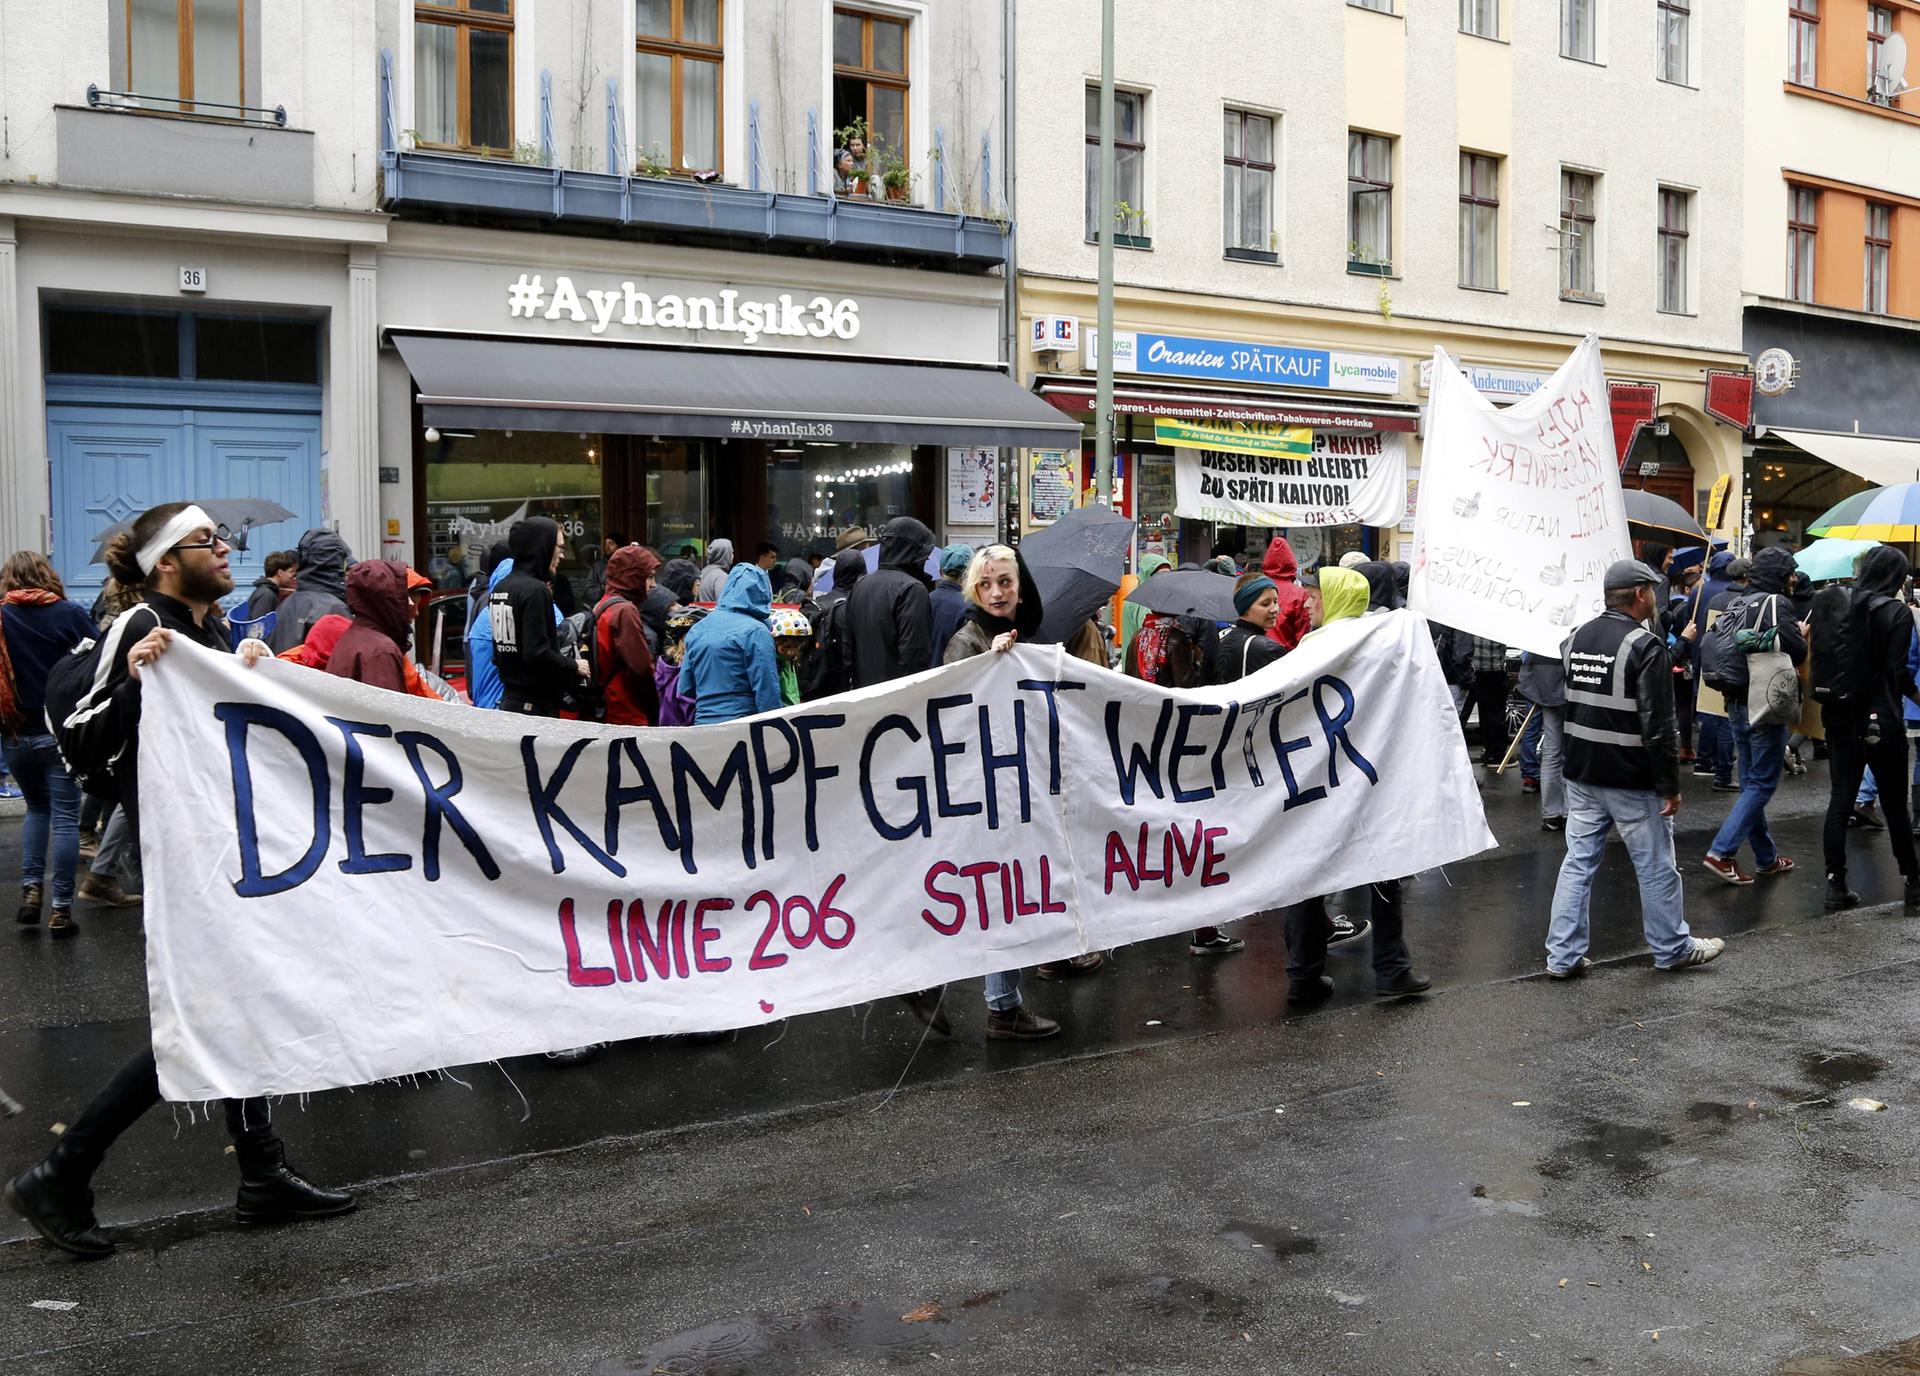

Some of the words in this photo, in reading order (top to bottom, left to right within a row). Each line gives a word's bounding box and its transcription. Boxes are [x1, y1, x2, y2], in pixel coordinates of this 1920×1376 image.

[184, 270, 200, 285] 36
[1113, 338, 1132, 350] yca
[1148, 340, 1225, 369] Oranien
[1231, 348, 1322, 377] SPÄTKAUF
[1333, 362, 1397, 379] Lycamobile
[1657, 424, 1667, 433] 35
[1201, 450, 1256, 474] DIESER
[1307, 457, 1369, 480] BLEIBT!
[1200, 473, 1225, 499] BU
[1227, 477, 1274, 504] SPÄTI
[1278, 483, 1350, 507] KALIYOR!
[214, 702, 501, 898] DER
[521, 714, 847, 878] KAMPF
[860, 679, 1086, 841] GEHT
[1105, 674, 1379, 812] WEITER
[558, 897, 734, 988] LINIE
[748, 873, 856, 972] 206
[921, 855, 1067, 936] STILL
[1104, 819, 1231, 895] ALIVE
